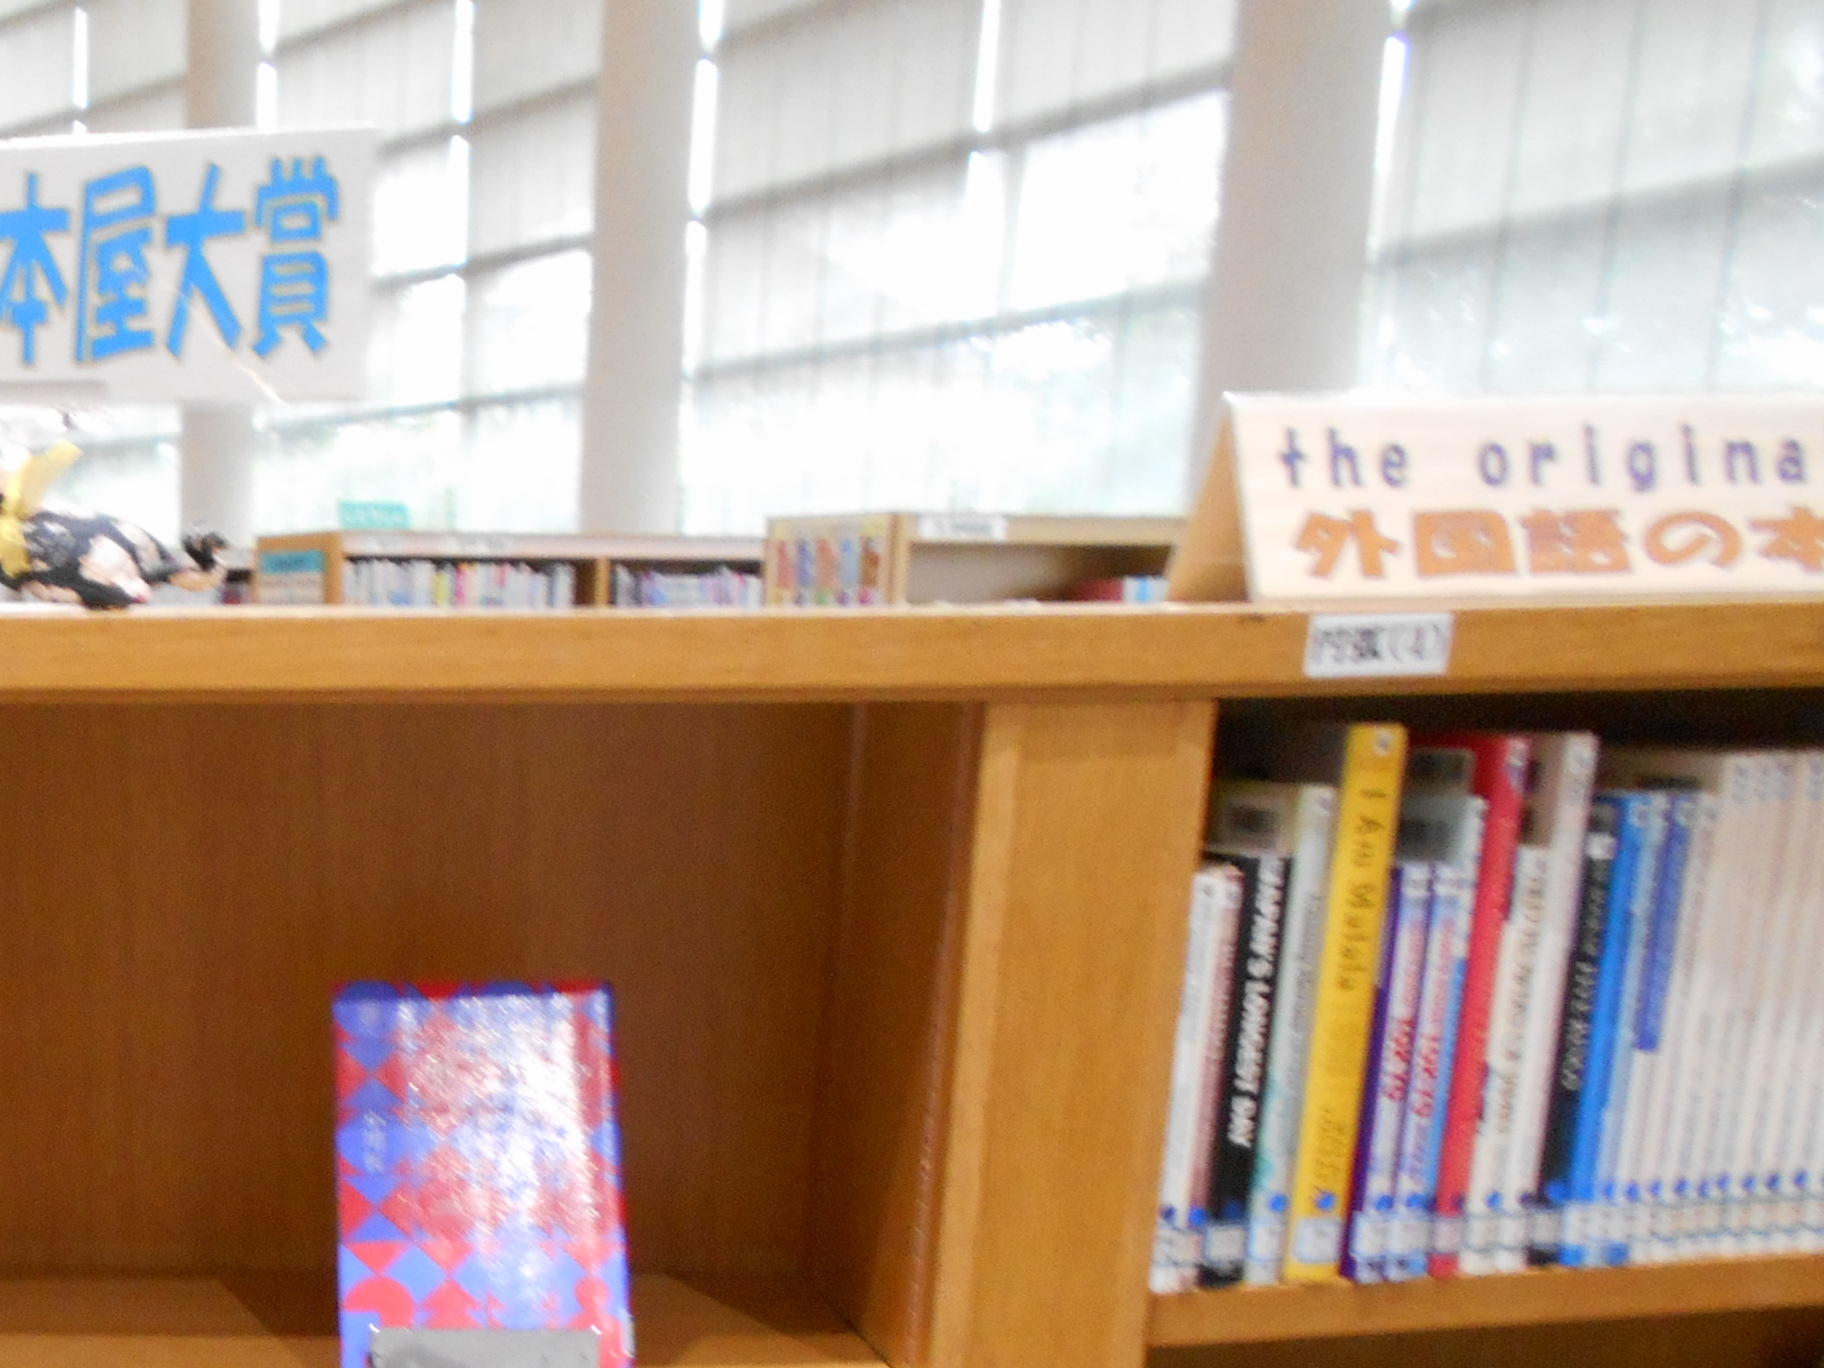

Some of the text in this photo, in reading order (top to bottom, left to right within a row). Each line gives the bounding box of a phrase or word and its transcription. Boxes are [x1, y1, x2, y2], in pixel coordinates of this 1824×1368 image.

[1279, 422, 1810, 492] the origina
[1295, 507, 1824, 579] 外国語の本
[1246, 858, 1288, 981] JAPAN'S
[1333, 885, 1379, 992] Malala
[1229, 1094, 1253, 1147] DAY
